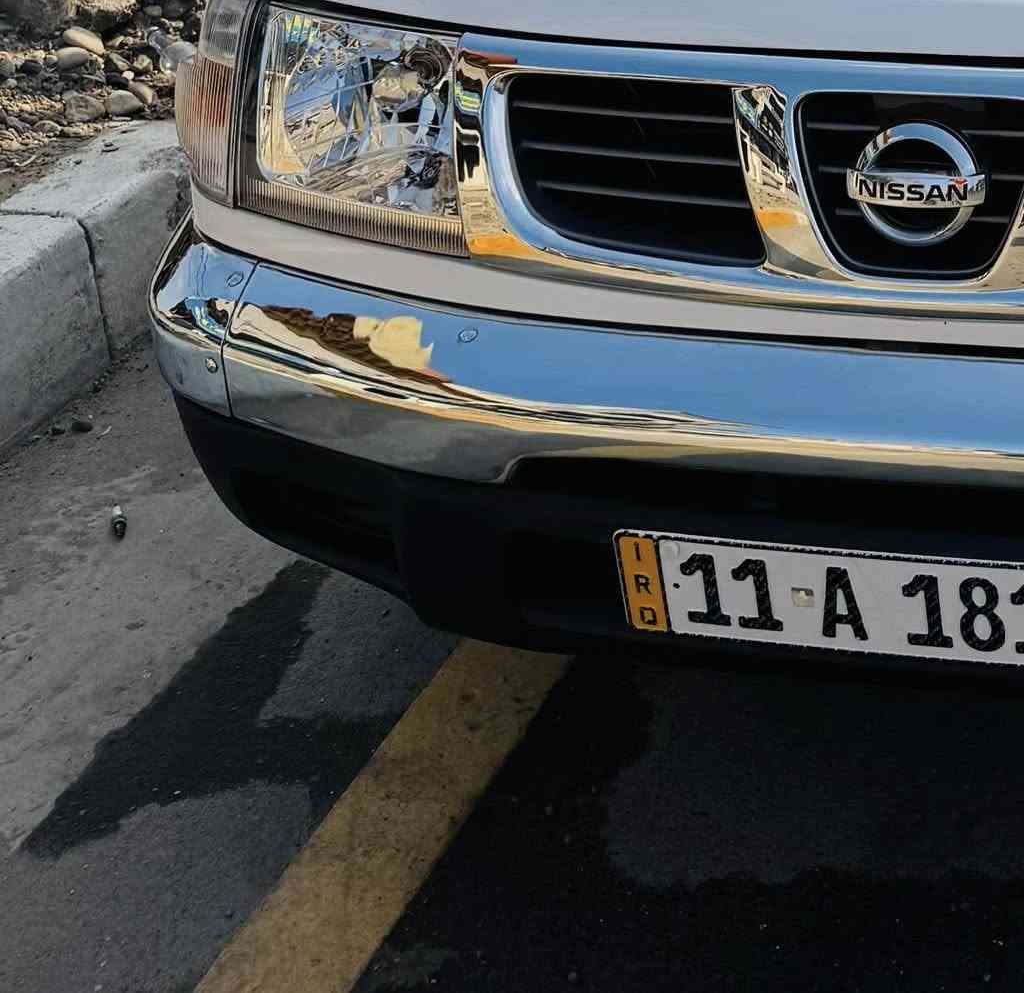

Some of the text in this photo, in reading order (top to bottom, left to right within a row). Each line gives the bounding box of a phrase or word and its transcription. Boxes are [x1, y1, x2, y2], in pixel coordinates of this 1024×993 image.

[857, 177, 969, 203] NISSAN
[679, 552, 784, 632] 11
[821, 566, 869, 641] A
